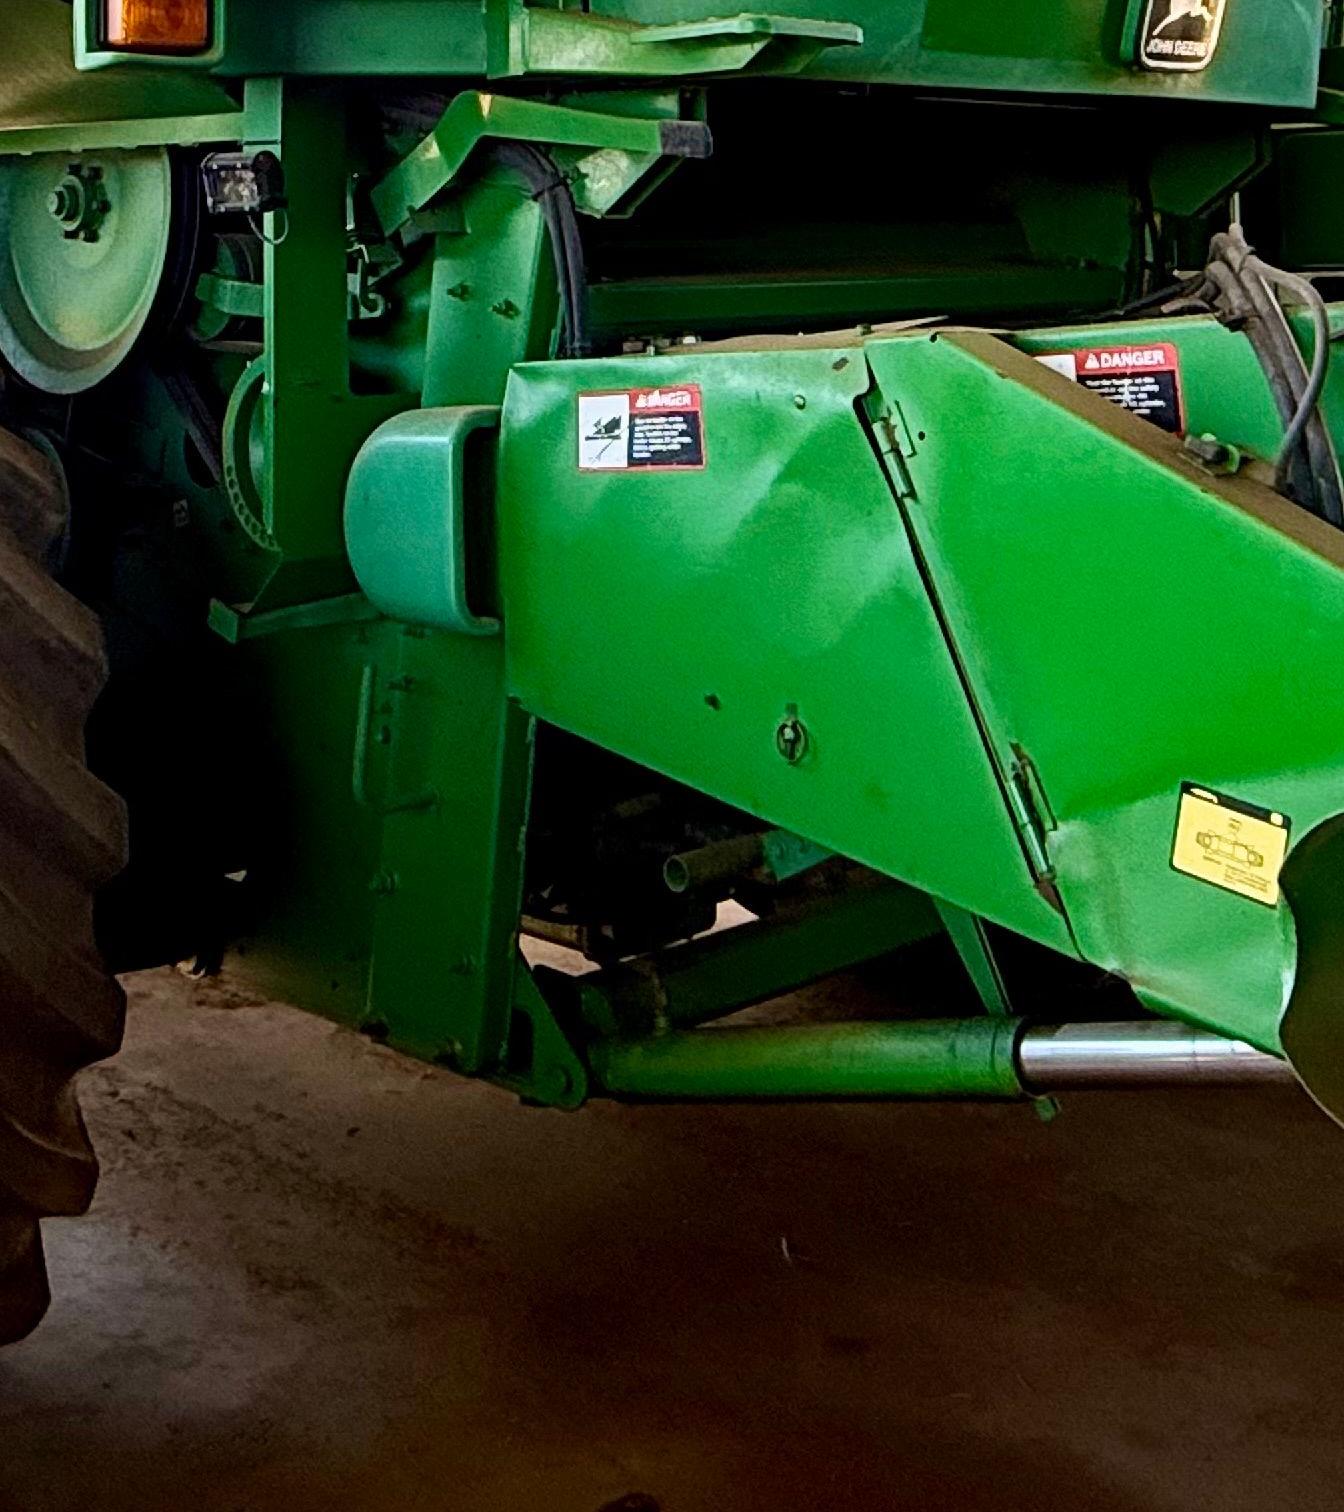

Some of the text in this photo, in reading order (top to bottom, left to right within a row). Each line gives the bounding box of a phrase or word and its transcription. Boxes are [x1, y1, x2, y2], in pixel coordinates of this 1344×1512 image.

[1174, 40, 1209, 58] DEERE
[1100, 350, 1165, 368] DANGER
[647, 389, 692, 408] DANGER
